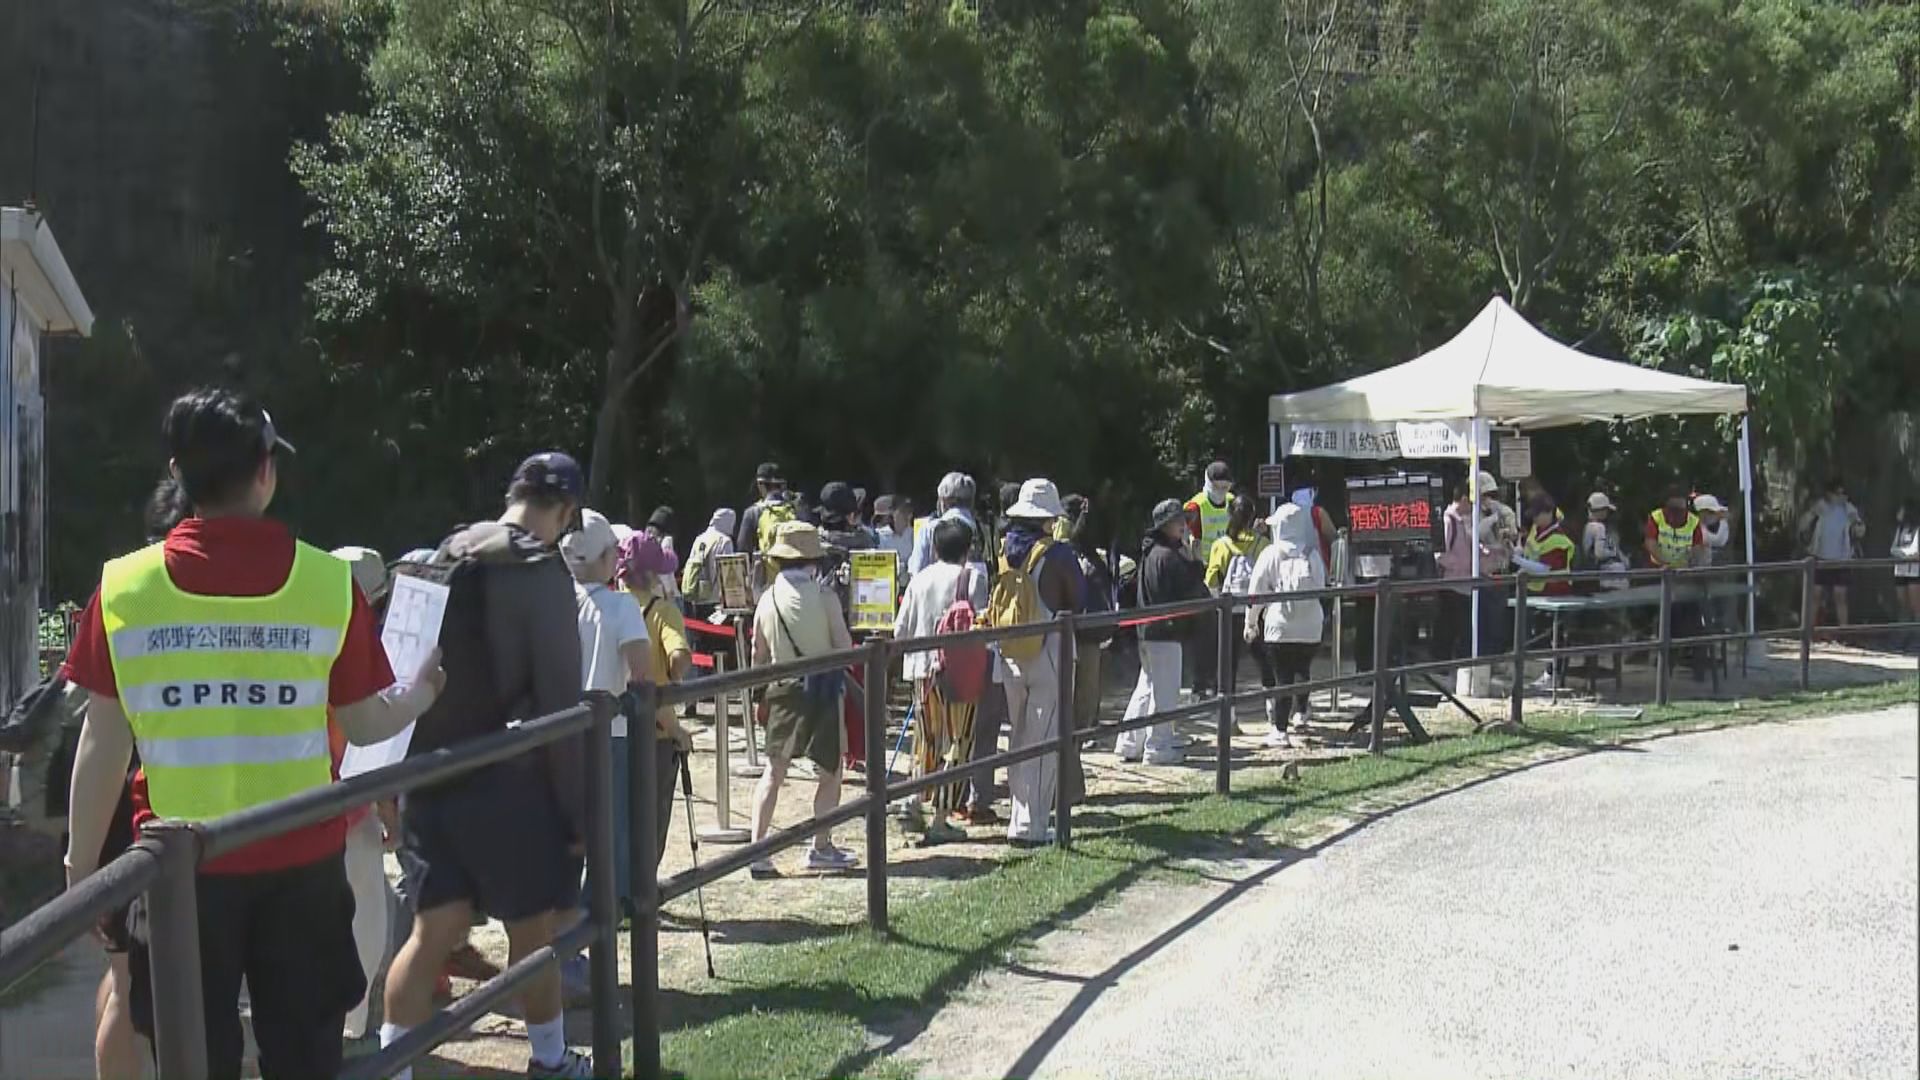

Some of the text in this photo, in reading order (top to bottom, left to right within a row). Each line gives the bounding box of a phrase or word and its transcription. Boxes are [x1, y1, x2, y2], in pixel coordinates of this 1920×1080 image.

[1349, 500, 1431, 530] 預約核證
[147, 625, 310, 651] 郊野公園護理科
[162, 683, 297, 707] CPRSD
